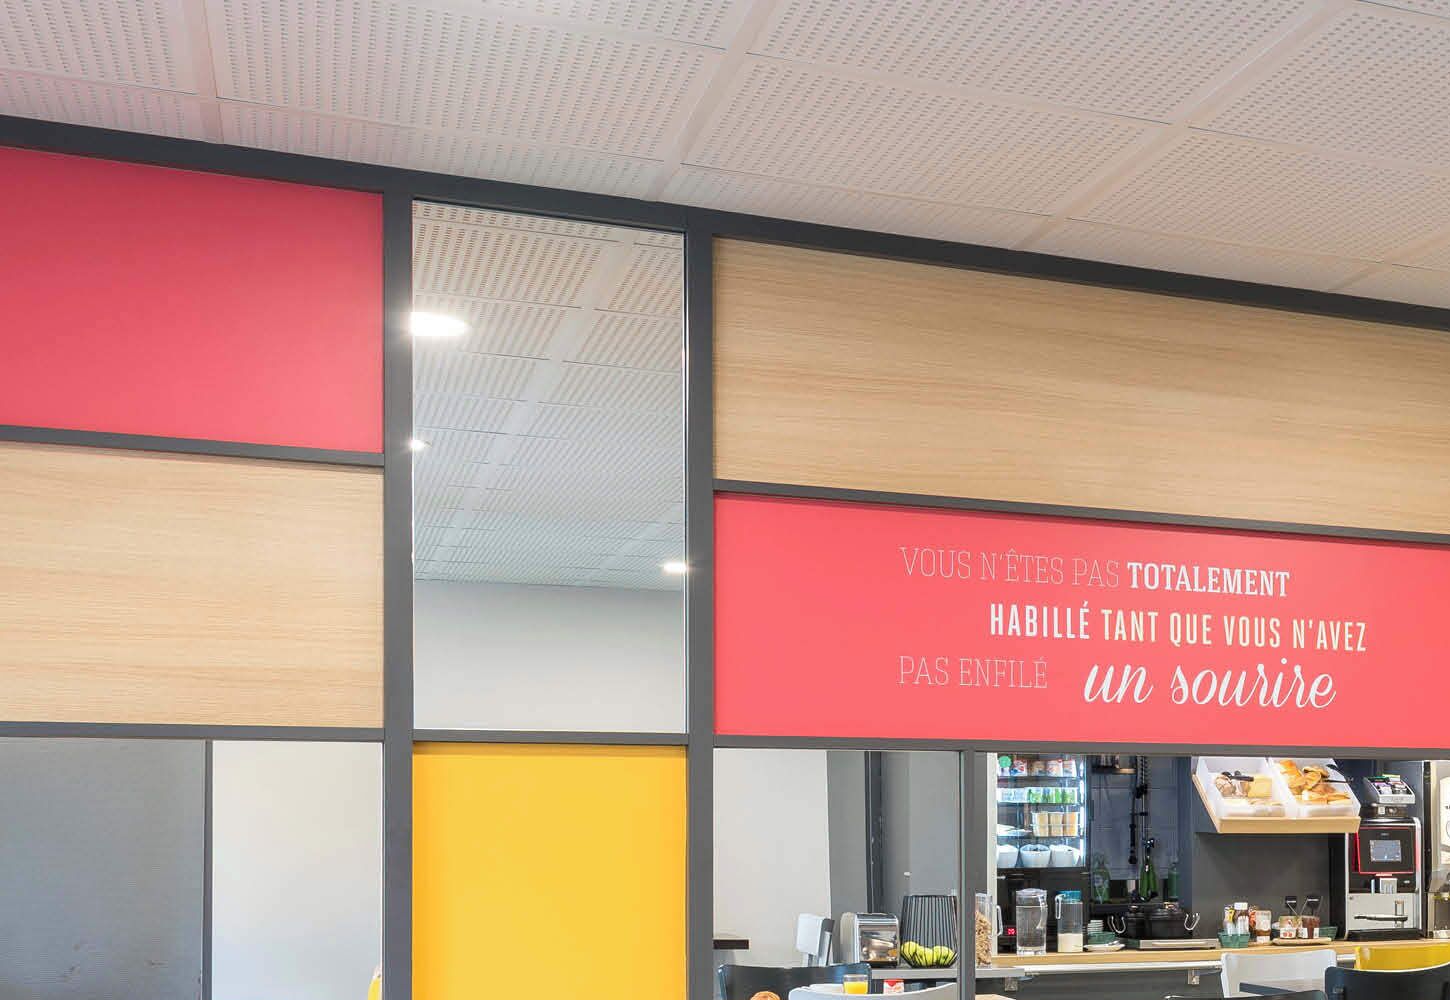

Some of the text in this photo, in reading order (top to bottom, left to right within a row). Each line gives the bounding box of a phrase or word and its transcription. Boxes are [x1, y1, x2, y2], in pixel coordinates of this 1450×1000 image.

[899, 547, 1290, 597] VOUS N'ÊTES PAS TOTALEMENT
[989, 600, 1368, 653] HABILLÉ TANT QUE VOUS N'AVEZ
[898, 655, 1338, 709] PAS ENFILÉ un sourire
